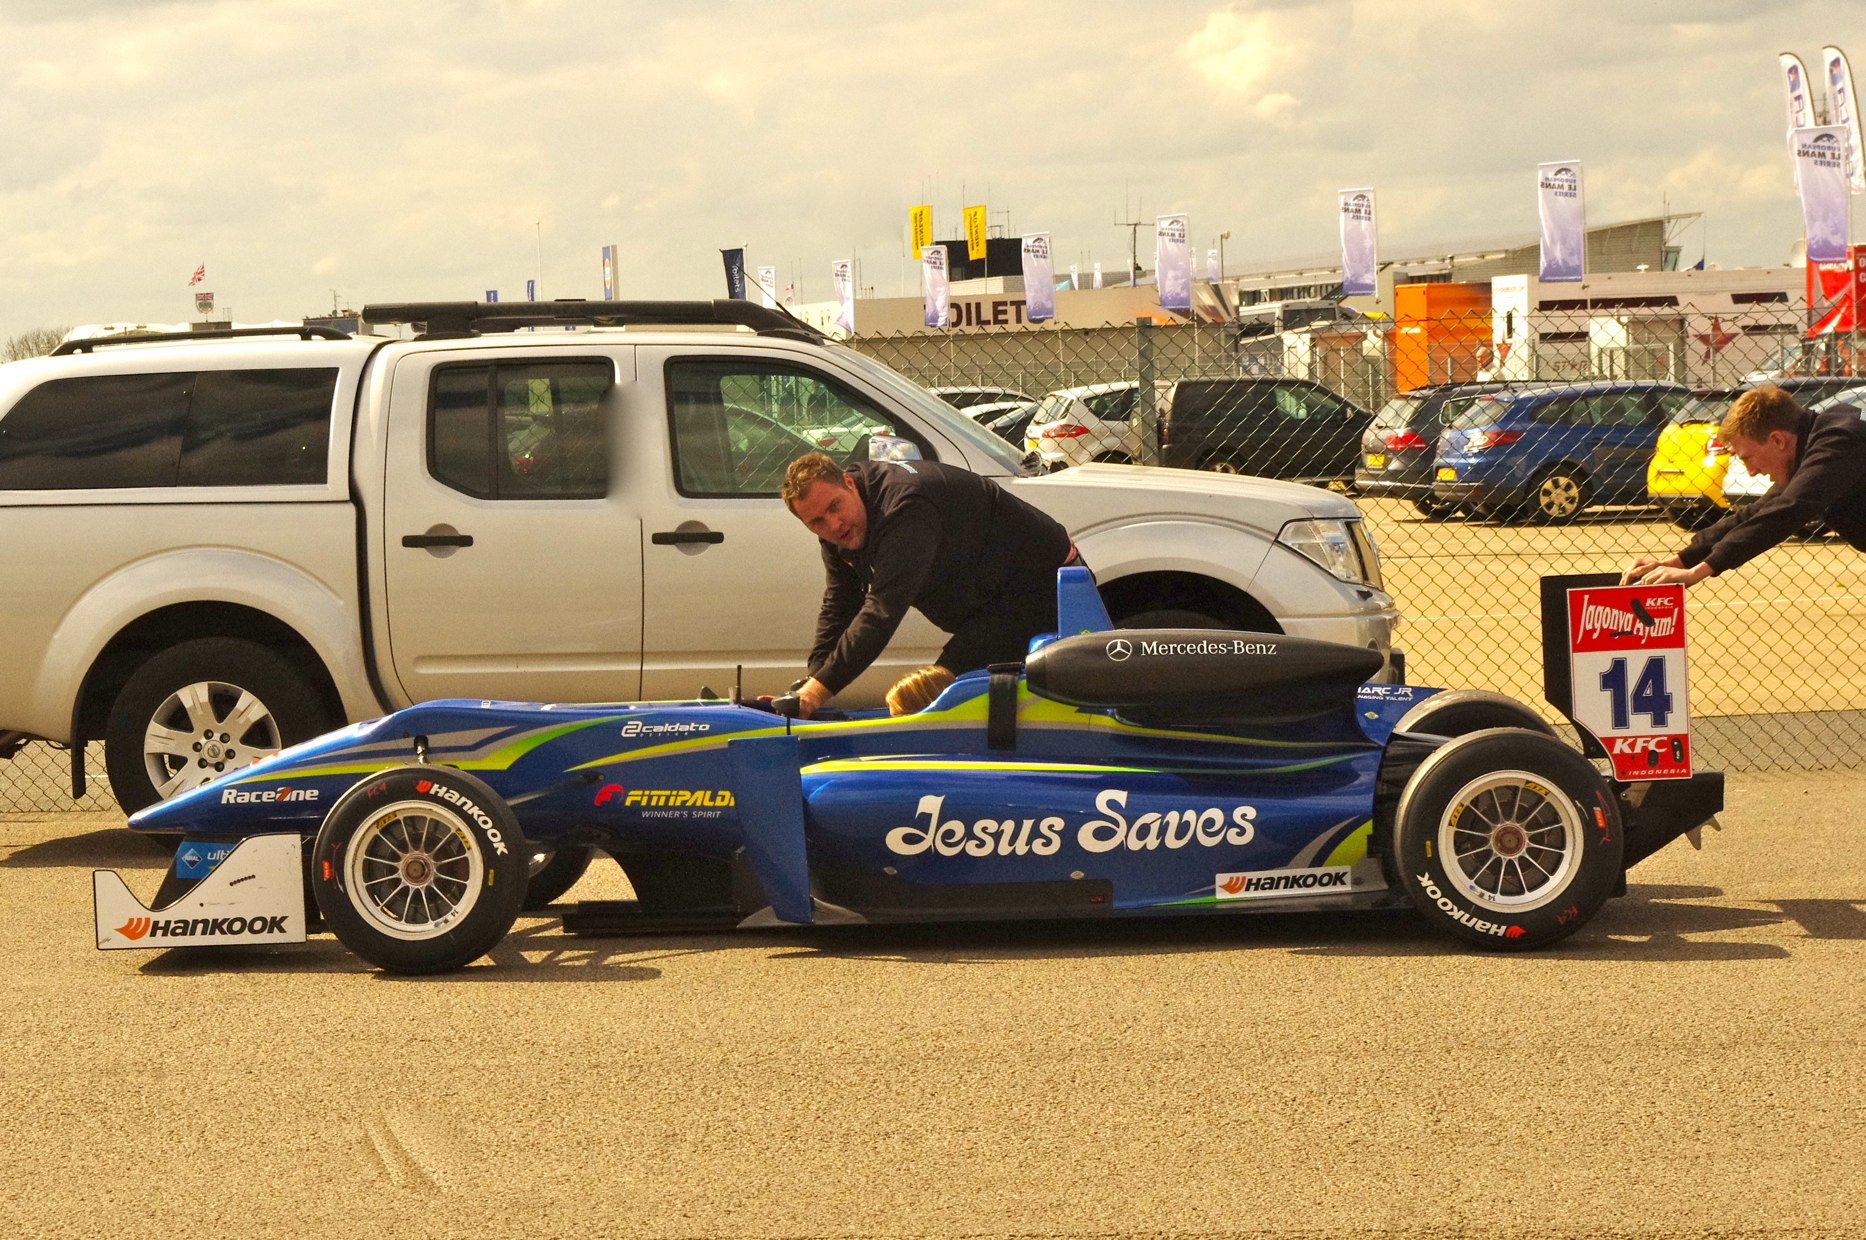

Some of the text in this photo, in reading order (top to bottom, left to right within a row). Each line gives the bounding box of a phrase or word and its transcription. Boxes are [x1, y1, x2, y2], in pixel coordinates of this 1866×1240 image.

[1645, 597, 1674, 606] KFC
[1140, 639, 1278, 657] Mercedes-Benz
[1394, 687, 1413, 697] JR
[1600, 656, 1673, 730] 14
[1612, 736, 1669, 754] KFC
[1628, 768, 1687, 776] INDONESIA
[641, 810, 721, 819] WINNER'S SPIRIT
[885, 789, 1258, 857] Jesus Saves
